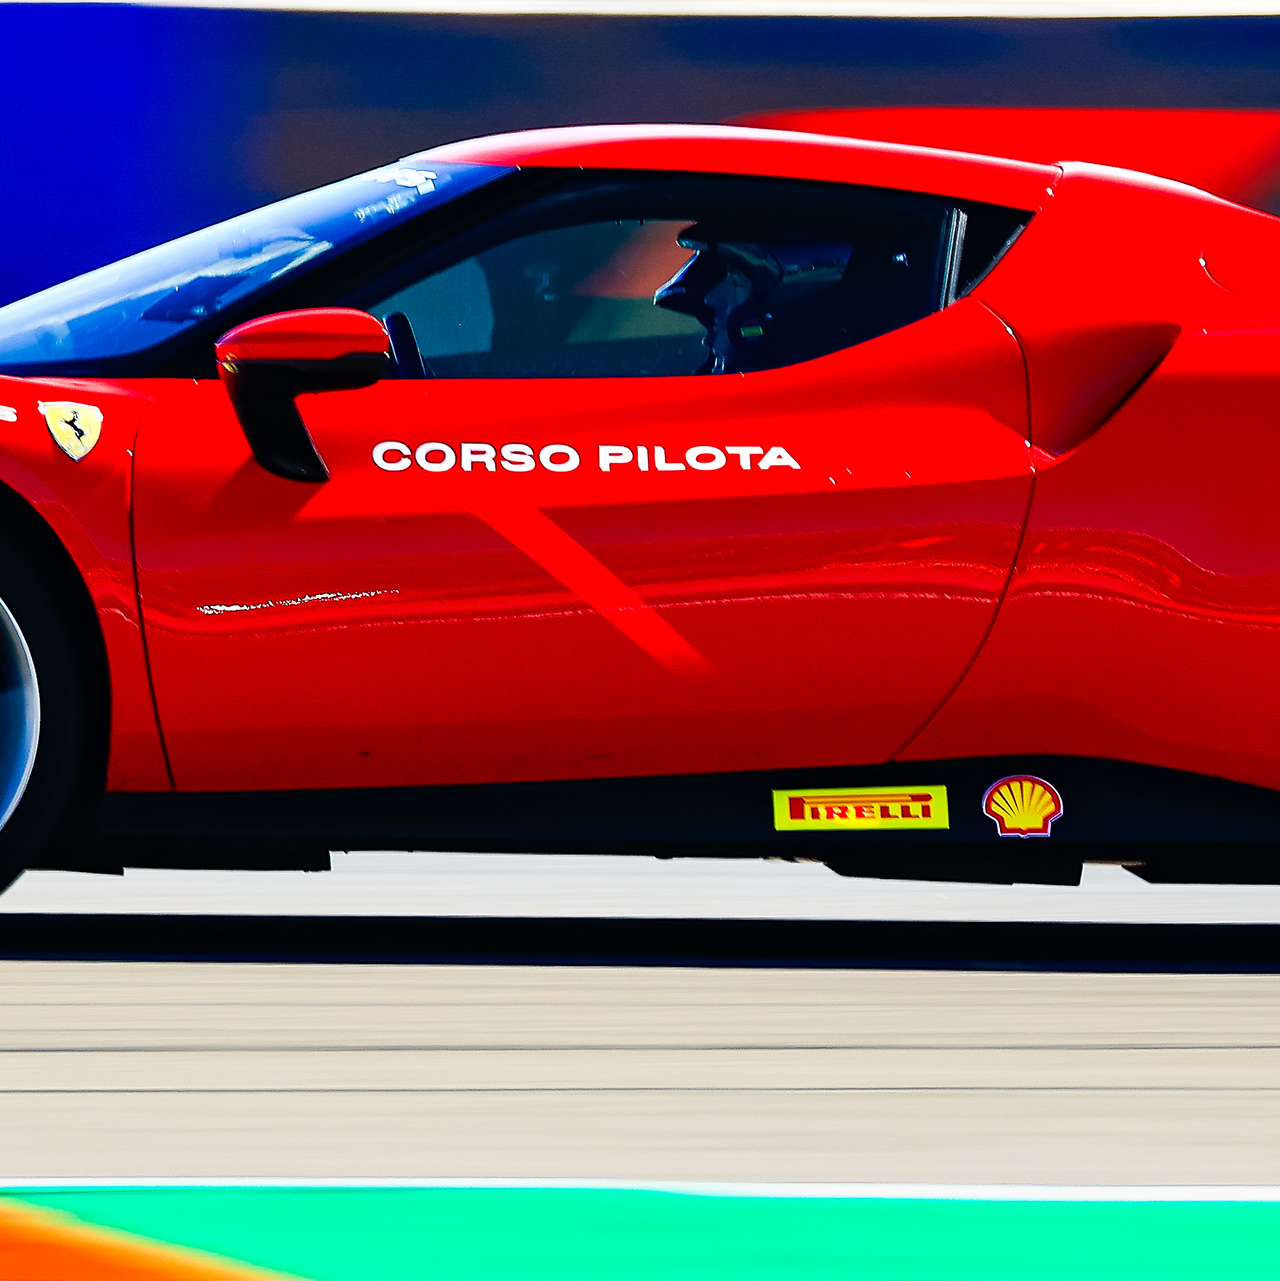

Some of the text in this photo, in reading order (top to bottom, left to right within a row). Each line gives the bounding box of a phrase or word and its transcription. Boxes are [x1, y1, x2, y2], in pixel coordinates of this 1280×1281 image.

[371, 440, 801, 472] CORSO PILOTA
[788, 792, 933, 821] PIRELLI
